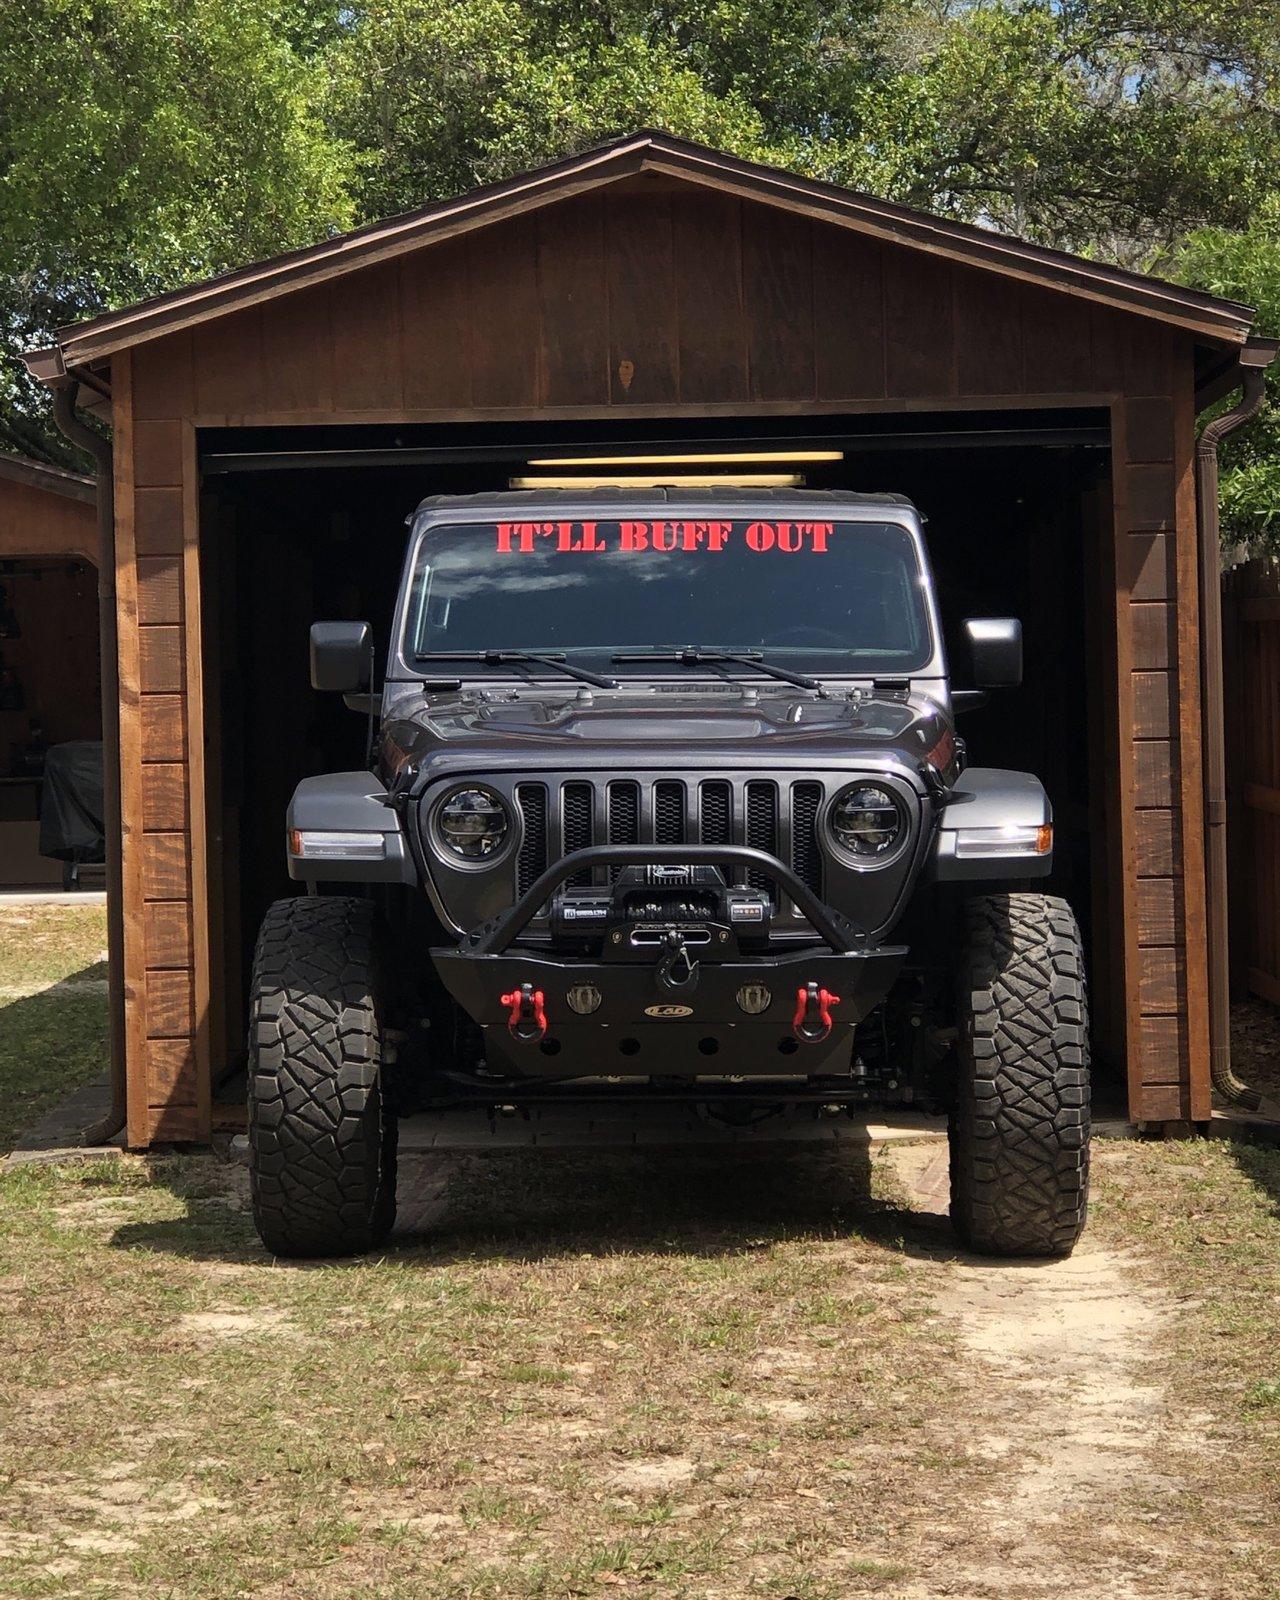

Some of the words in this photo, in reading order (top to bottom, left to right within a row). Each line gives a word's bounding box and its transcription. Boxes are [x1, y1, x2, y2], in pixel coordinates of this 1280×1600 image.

[497, 522, 605, 552] IT'LL
[619, 521, 732, 551] BUFF
[745, 521, 834, 552] OUT
